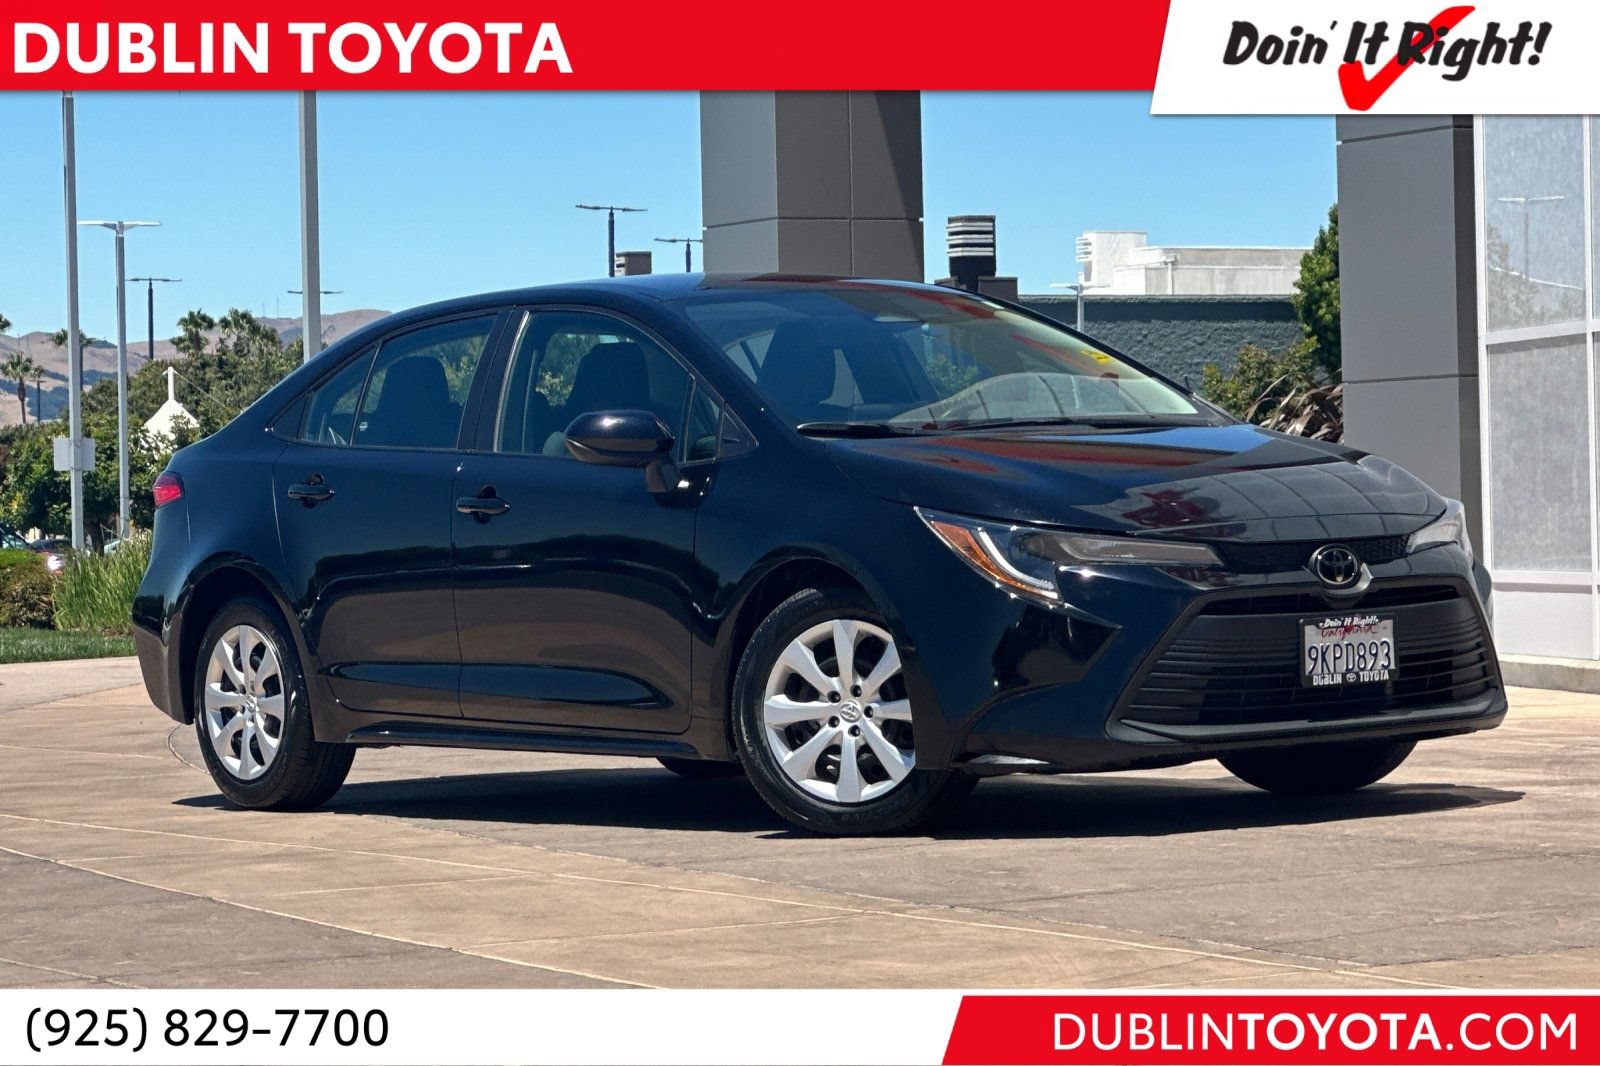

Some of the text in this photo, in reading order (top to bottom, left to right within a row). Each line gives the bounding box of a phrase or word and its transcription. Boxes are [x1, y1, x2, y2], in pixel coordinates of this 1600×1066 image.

[1343, 617, 1352, 626] It
[1321, 624, 1377, 640] Califrnia
[1308, 640, 1391, 675] 9KPD893
[1313, 670, 1389, 686] DUBLIN TOYOTA
